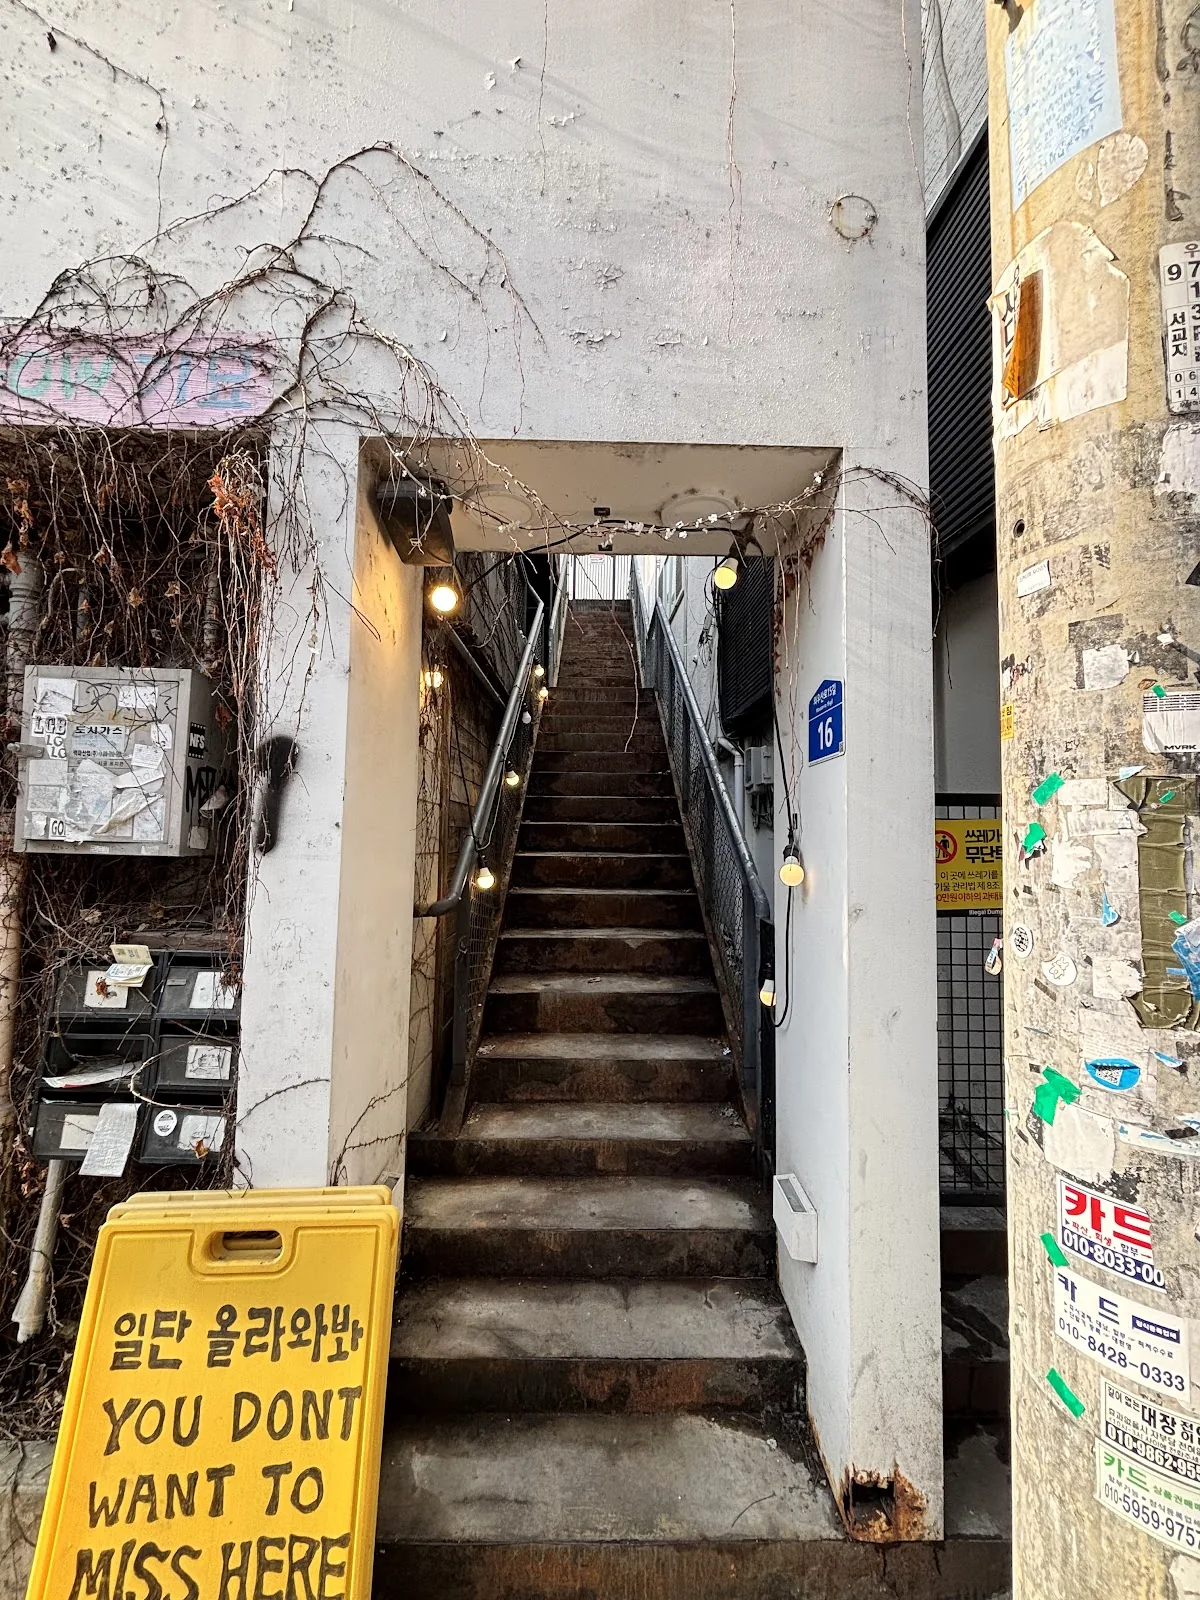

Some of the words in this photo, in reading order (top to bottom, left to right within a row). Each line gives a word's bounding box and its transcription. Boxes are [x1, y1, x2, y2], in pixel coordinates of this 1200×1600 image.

[75, 725, 123, 735] 도시가스
[189, 732, 205, 749] NFS
[818, 716, 833, 750] 16
[51, 820, 67, 836] GO
[965, 829, 1003, 843] 쓰레기
[1065, 1185, 1152, 1250] 카드
[109, 1308, 192, 1371] 일단
[206, 1303, 364, 1369] 올라와봐
[1058, 1317, 1186, 1392] 010-8428-0333
[102, 1394, 203, 1456] YOU
[231, 1385, 363, 1443] DONT
[1141, 1404, 1177, 1436] 대장
[1103, 1451, 1150, 1492] 카드
[88, 1463, 236, 1529] WANT
[262, 1461, 324, 1516] TO
[67, 1538, 202, 1600] MISS
[217, 1532, 351, 1600] HERE
